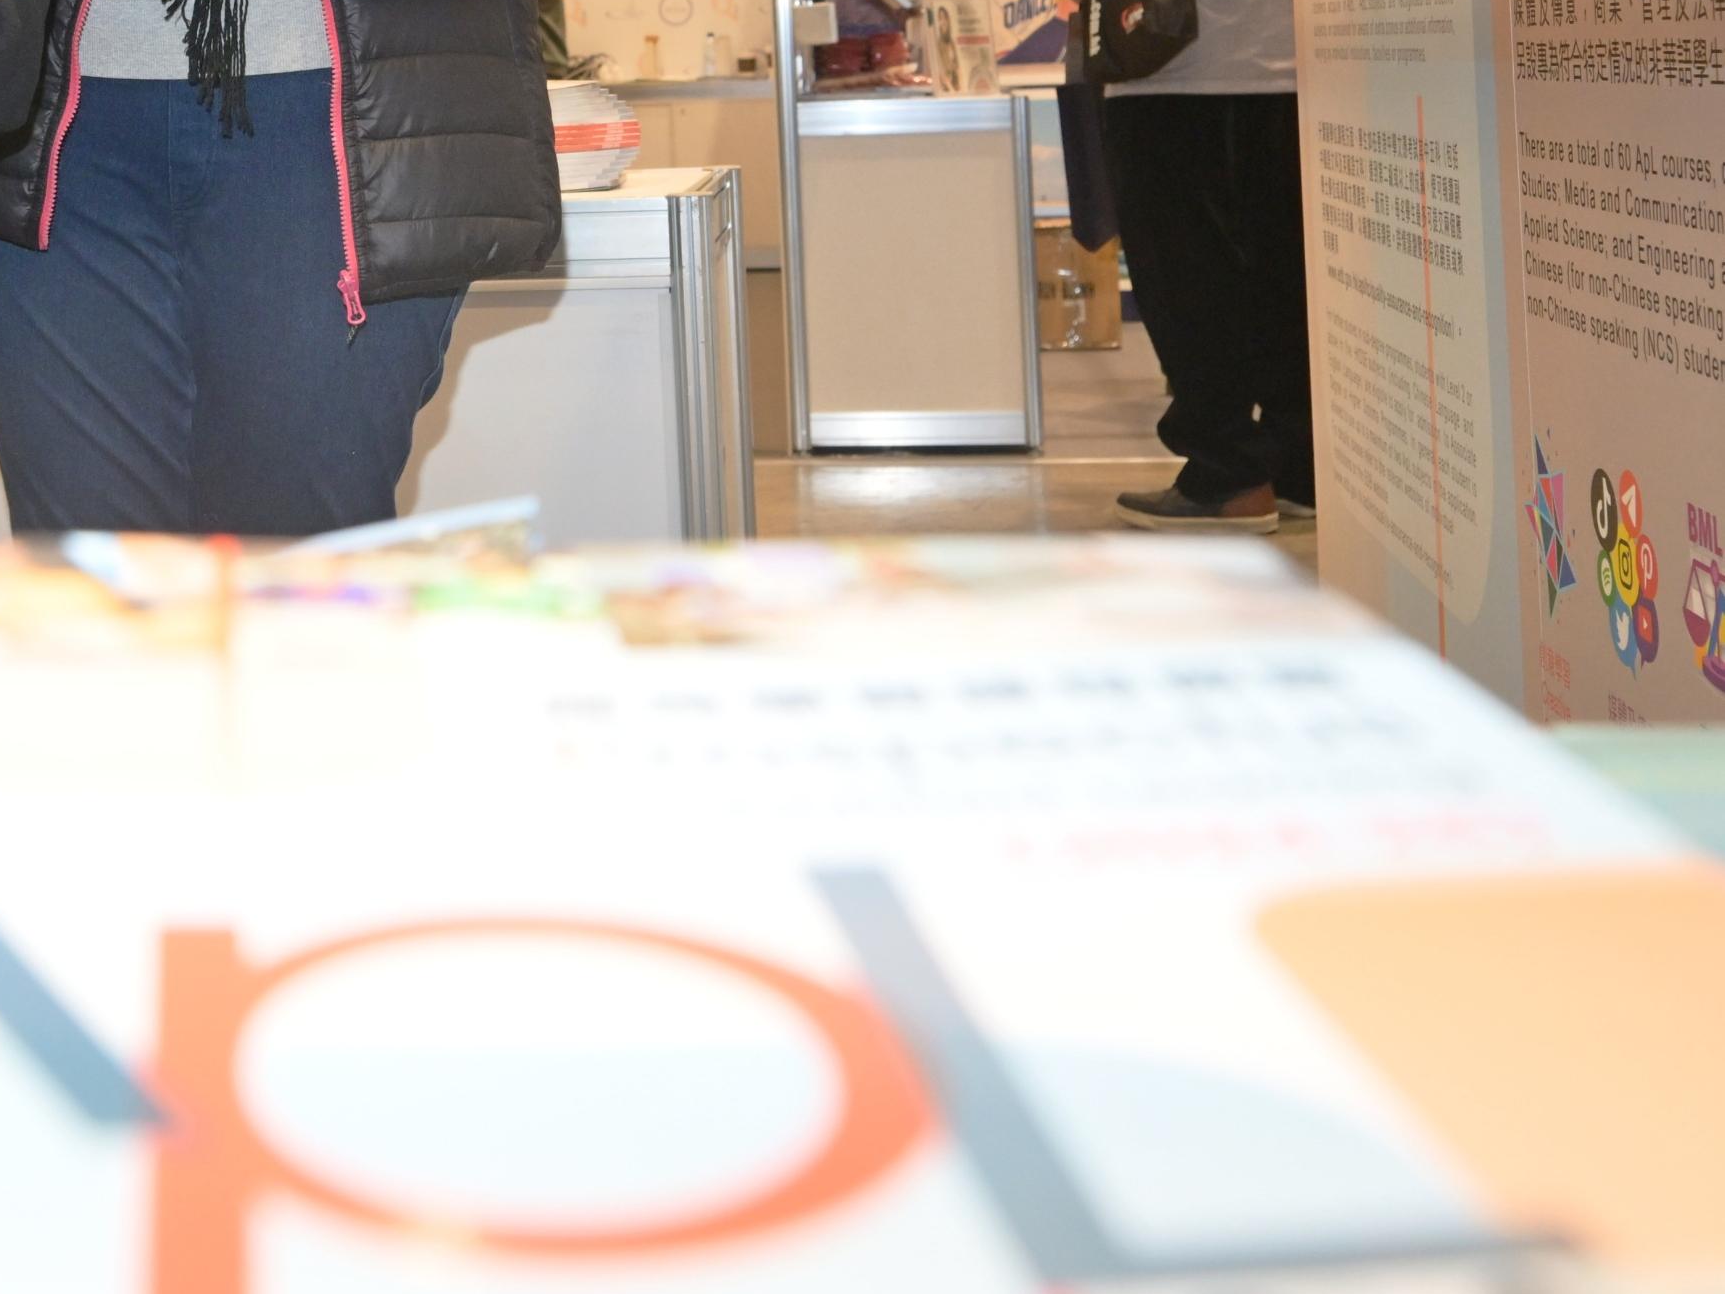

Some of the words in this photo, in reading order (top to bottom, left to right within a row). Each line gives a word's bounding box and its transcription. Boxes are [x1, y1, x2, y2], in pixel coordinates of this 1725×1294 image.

[1519, 131, 1545, 160] There
[1549, 139, 1564, 163] are
[1567, 143, 1574, 163] a
[1577, 137, 1600, 167] total
[1604, 141, 1614, 169] of
[1618, 142, 1632, 172] 60
[1636, 145, 1658, 181] ApL
[1662, 153, 1717, 188] courses,
[1522, 170, 1562, 206] Studies;
[1564, 177, 1596, 209] Media
[1600, 186, 1620, 214] and
[1626, 187, 1725, 235] Communication
[1524, 210, 1559, 243] Applied
[1562, 218, 1609, 259] Science;
[1612, 233, 1633, 261] and
[1638, 235, 1716, 290] Engineering
[1525, 249, 1563, 285] Chinese
[1567, 259, 1585, 295] (for
[1589, 273, 1660, 314] non-Chinese
[1665, 294, 1724, 342] speaking
[1527, 294, 1586, 333] non-Chinese
[1590, 315, 1639, 359] speaking
[1643, 326, 1679, 375] (NCS)
[1687, 502, 1724, 557] BML
